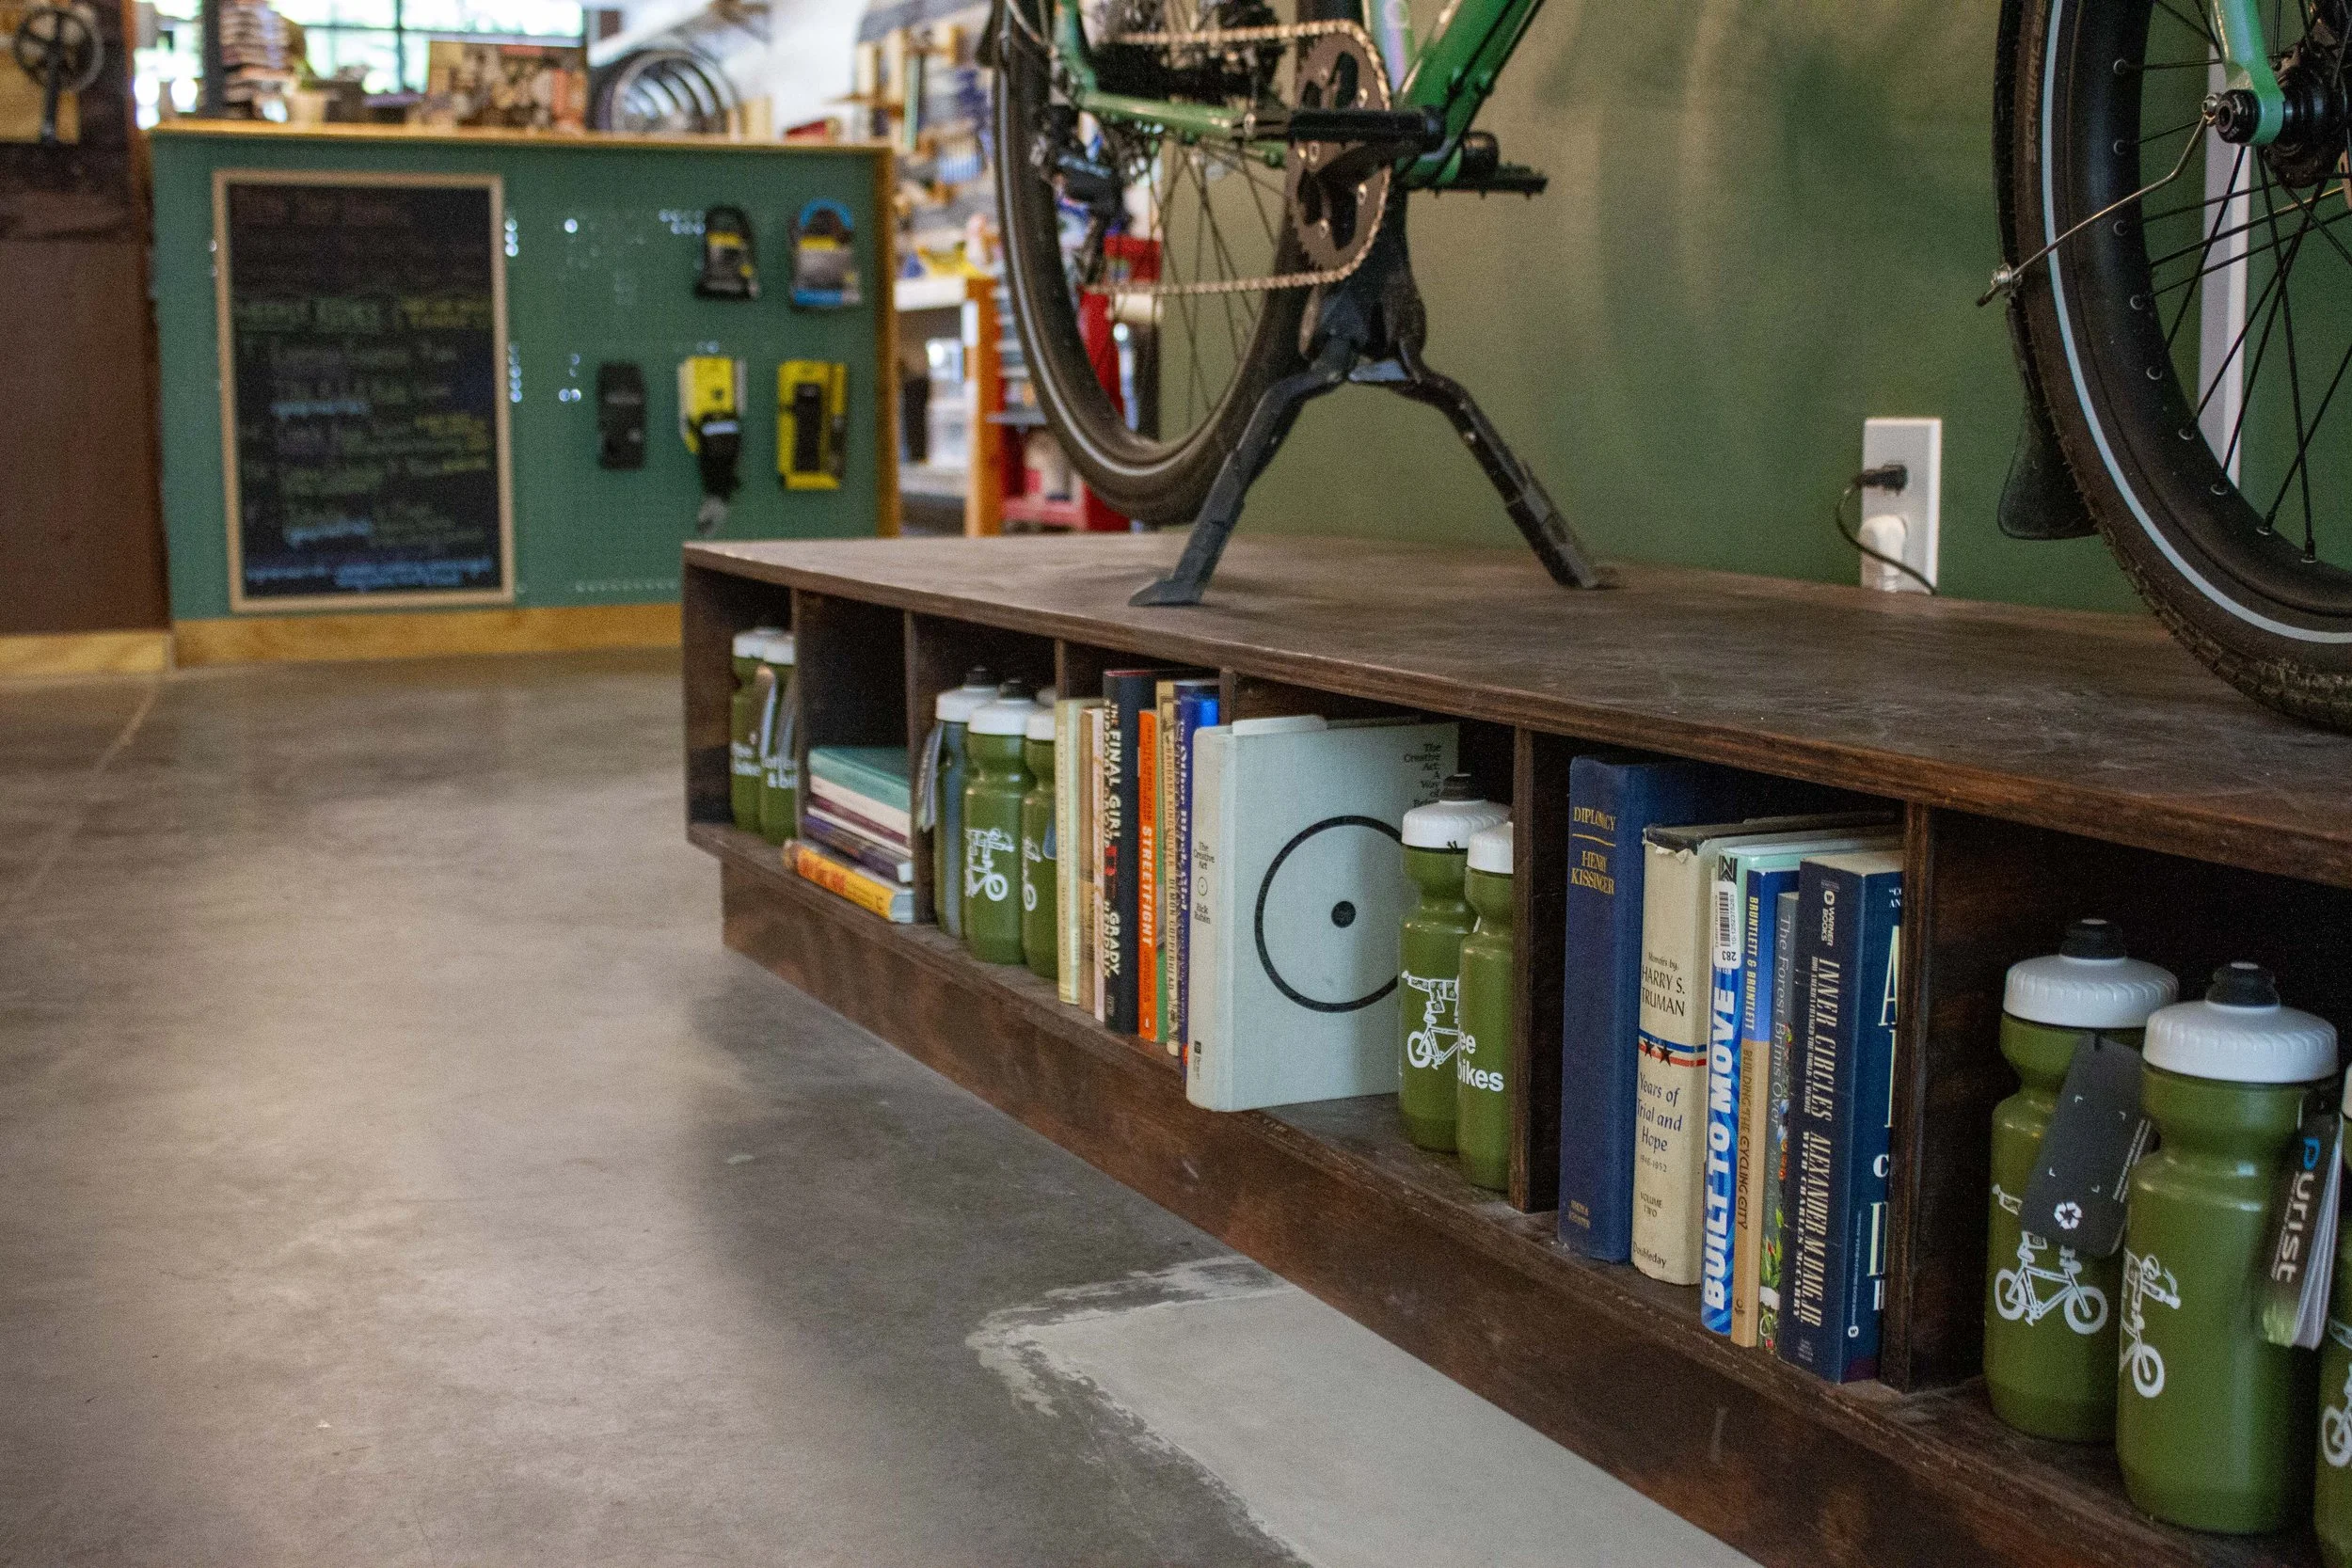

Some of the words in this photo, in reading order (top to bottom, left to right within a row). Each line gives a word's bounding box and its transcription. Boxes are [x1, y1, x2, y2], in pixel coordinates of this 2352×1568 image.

[1109, 729, 1121, 786] FINAL
[1404, 753, 1440, 762] Creative
[1423, 743, 1441, 752] The
[1109, 794, 1121, 837] GIRL
[1194, 848, 1215, 863] Creative
[1199, 841, 1209, 851] The
[1581, 850, 1607, 873] HENRY
[1199, 861, 1207, 870] Act
[1141, 824, 1152, 947] STREETFIGHT
[1168, 879, 1177, 916] DEMON
[1109, 912, 1120, 975] GRADY
[1747, 895, 1759, 956] BRUNTLETT
[1779, 914, 1791, 950] The
[1669, 959, 1678, 972] by
[1722, 950, 1737, 962] 283
[1642, 964, 1673, 990] HARRY
[1676, 977, 1685, 994] S.
[1775, 956, 1789, 1016] Forest
[1816, 958, 1840, 1027] INNER
[1642, 987, 1685, 1017] TRUMAN
[1745, 971, 1756, 1031] BRUNTLETT
[1709, 987, 1735, 1112] MOVE
[1772, 1022, 1787, 1077] Brims
[1640, 1072, 1662, 1099] Years
[1666, 1087, 1680, 1107] of
[1741, 1049, 1754, 1106] BUILDING
[1811, 1035, 1836, 1121] CIRCLES
[1637, 1098, 1655, 1122] Trial
[1657, 1115, 1682, 1132] and
[1771, 1081, 1783, 1129] Over
[1804, 1085, 1812, 1114] MEMOIR
[1740, 1108, 1752, 1132] THE
[1642, 1125, 1668, 1153] Hope
[1708, 1121, 1730, 1175] TO
[1801, 1131, 1810, 1169] WITH
[1739, 1134, 1750, 1195] CYCLING
[1640, 1192, 1662, 1209] VOLUME
[1804, 1131, 1832, 1236] ALEXANDER
[1644, 1205, 1658, 1217] TWO
[1737, 1196, 1748, 1229] CITY
[1797, 1176, 1807, 1244] CHARLES
[1633, 1241, 1667, 1269] Doubleday
[1704, 1189, 1729, 1310] BUILT
[1804, 1236, 1826, 1258] M.
[1792, 1251, 1804, 1319] McCARRY
